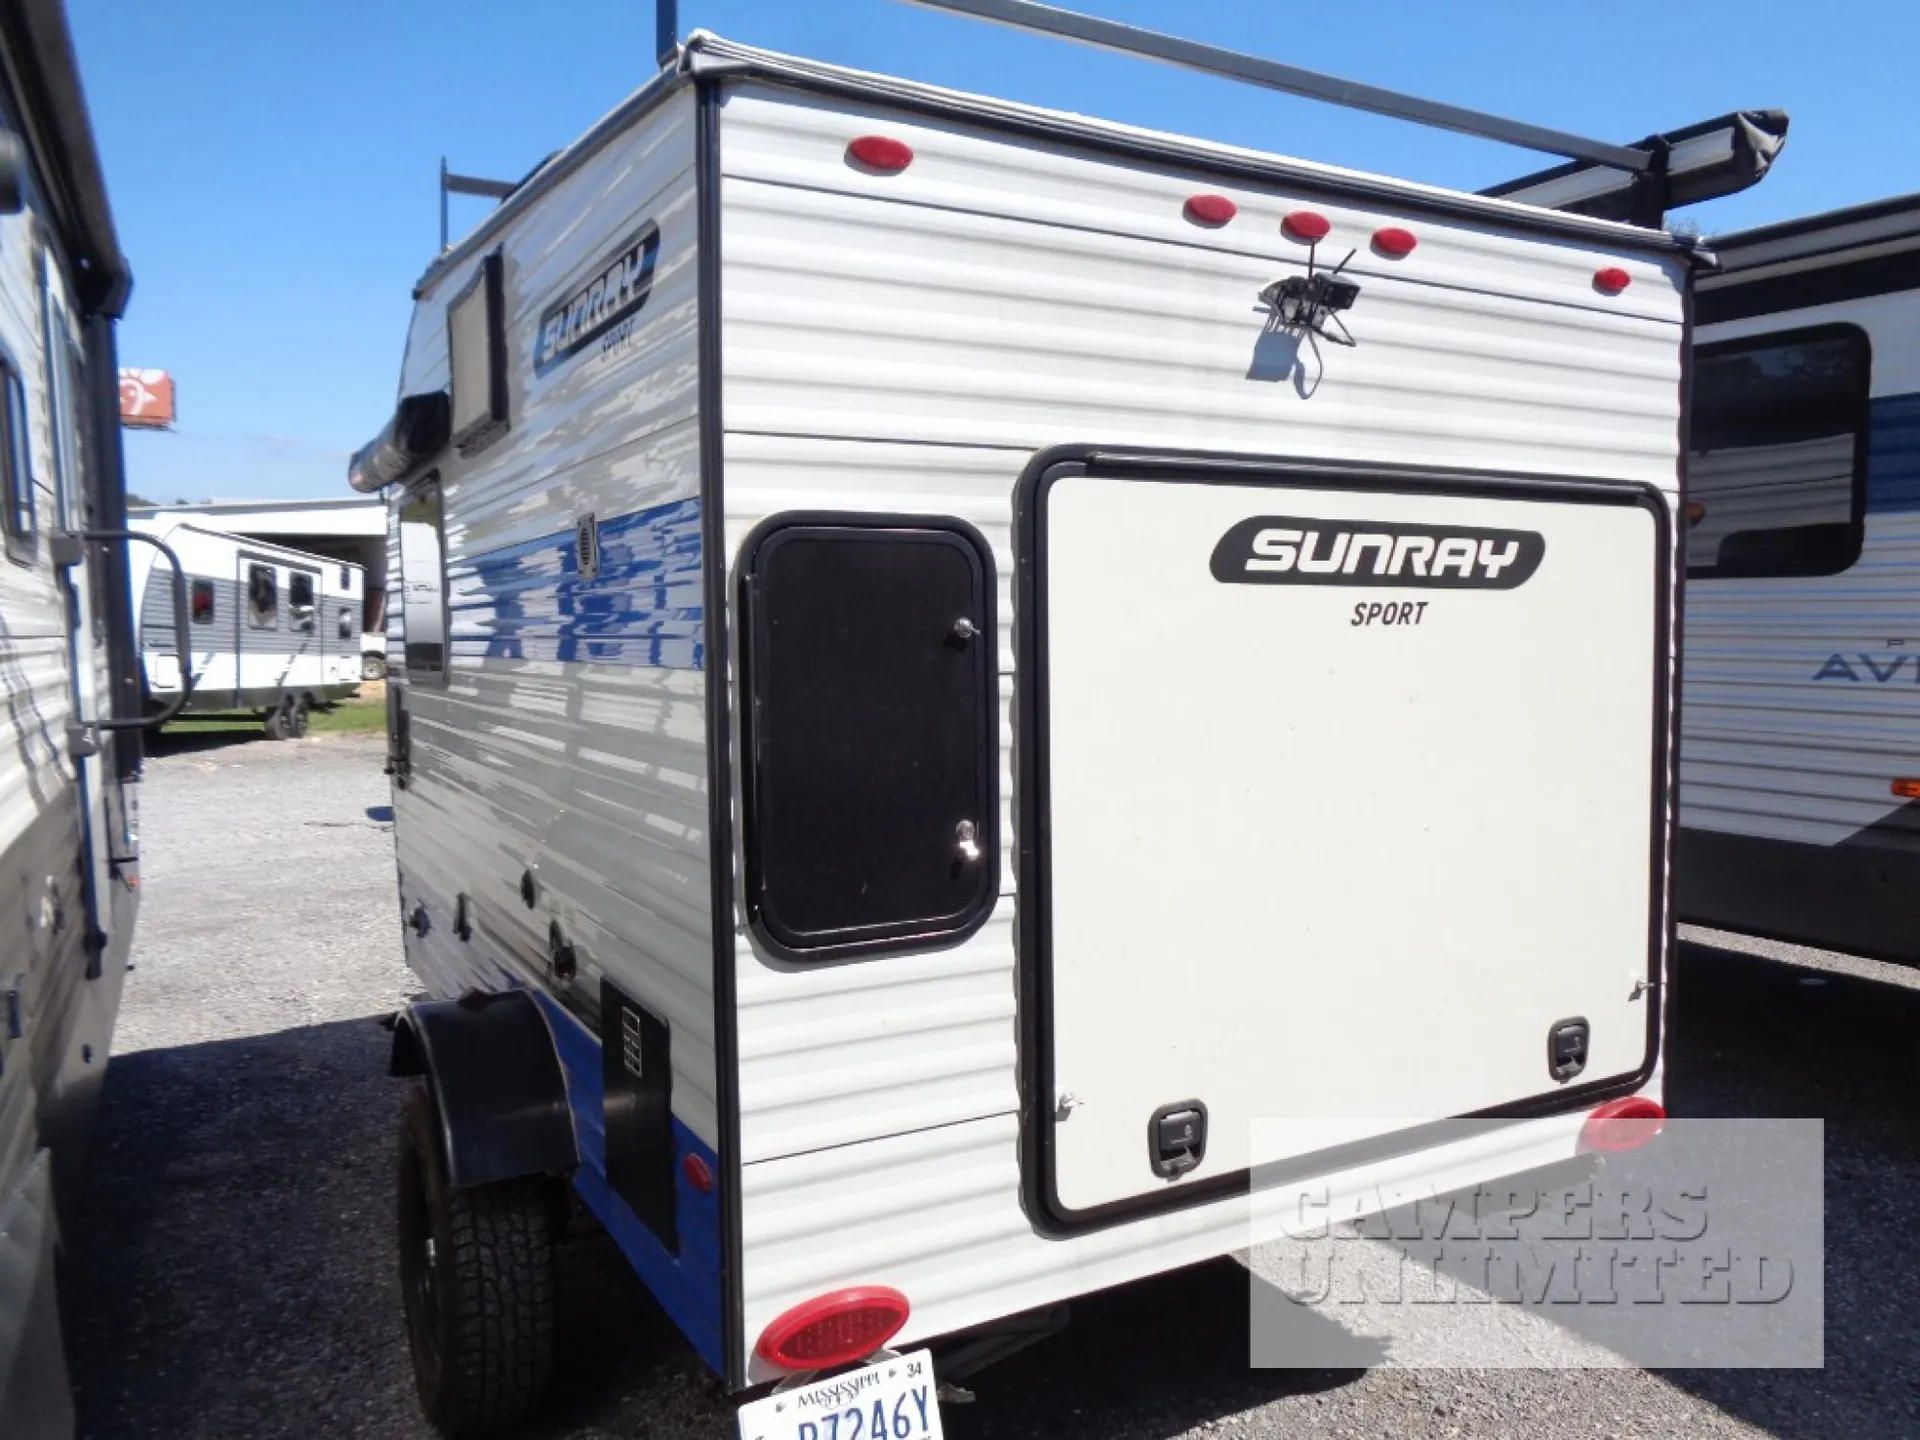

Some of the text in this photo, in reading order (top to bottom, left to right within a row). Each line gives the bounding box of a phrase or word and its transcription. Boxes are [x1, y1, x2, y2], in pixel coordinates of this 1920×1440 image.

[1244, 528, 1520, 578] SUNRAY
[1350, 601, 1429, 626] SPORT
[1810, 653, 1920, 683] AV
[907, 1361, 921, 1378] 34
